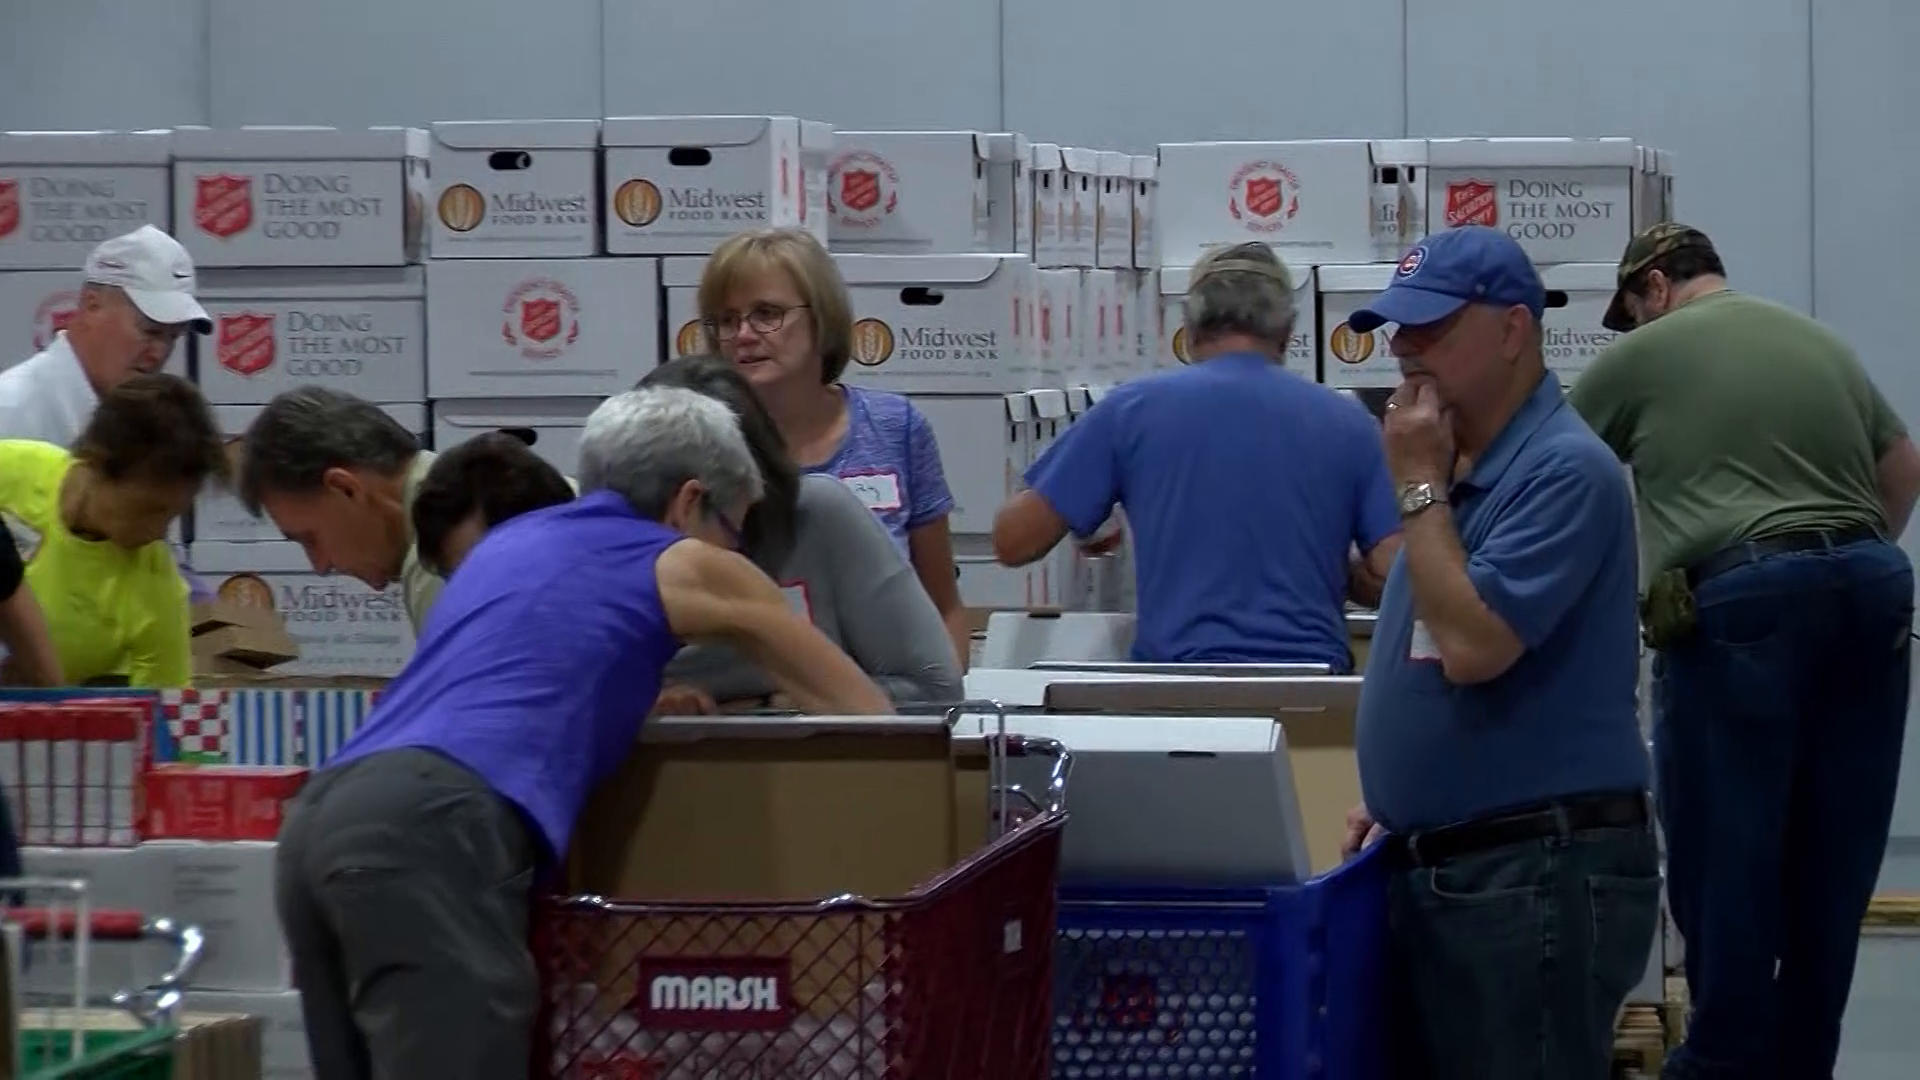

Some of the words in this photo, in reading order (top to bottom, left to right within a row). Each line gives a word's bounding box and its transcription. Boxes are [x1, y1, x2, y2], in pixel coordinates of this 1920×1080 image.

[264, 173, 350, 194] DOING
[1508, 179, 1583, 198] DOING
[491, 192, 587, 212] Midwest
[668, 187, 767, 208] Midwest
[264, 199, 312, 216] THE
[318, 198, 383, 217] MOST
[669, 211, 714, 220] FOOD
[720, 211, 767, 220] BANK
[1507, 203, 1547, 219] THE
[1554, 202, 1613, 219] MOST
[491, 215, 537, 225] FOOD
[543, 215, 589, 224] BANK
[263, 221, 341, 240] GOOD
[1507, 223, 1574, 240] GOOD
[287, 311, 373, 332] DOING
[287, 336, 335, 354] THE
[341, 335, 406, 354] MOST
[901, 326, 997, 347] Midwest
[901, 349, 947, 360] FOOD
[953, 349, 998, 360] BANK
[285, 358, 362, 377] GOOD
[279, 583, 402, 609] Midwest
[651, 975, 779, 1010] MARSH
